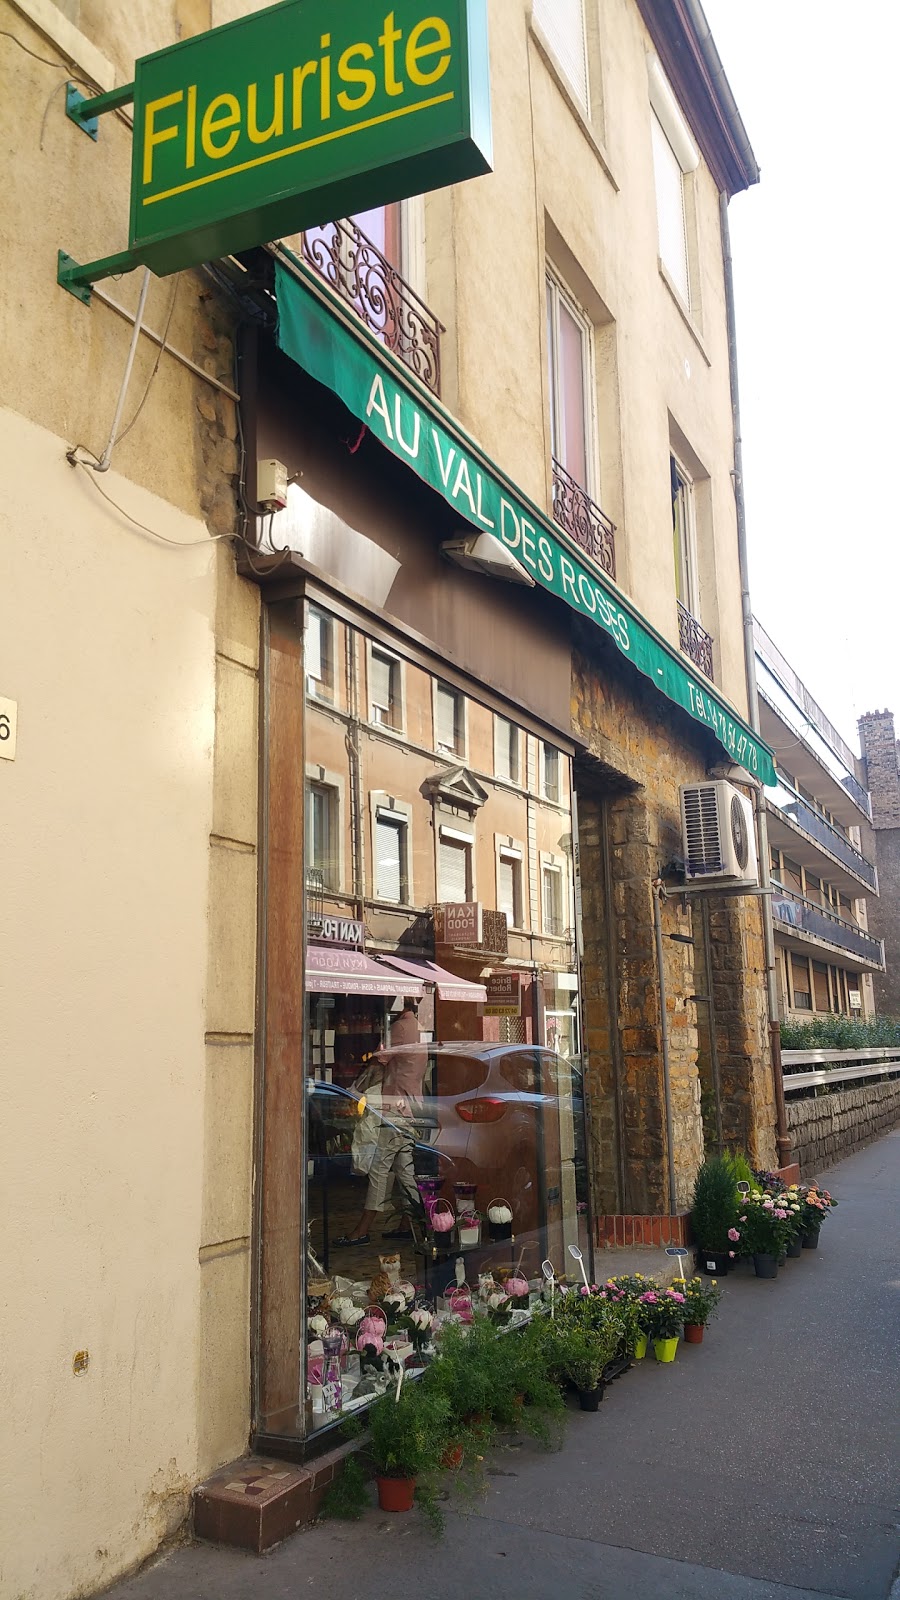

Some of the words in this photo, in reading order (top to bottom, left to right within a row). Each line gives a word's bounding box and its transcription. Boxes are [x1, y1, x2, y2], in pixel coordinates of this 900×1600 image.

[142, 11, 452, 185] Fleuriste
[366, 374, 420, 458] AU
[432, 429, 494, 528] VAL
[501, 497, 554, 582] DES
[561, 555, 630, 650] ROSES
[718, 712, 726, 743] 78
[728, 722, 736, 753] 54
[737, 734, 747, 761] 47
[748, 743, 758, 771] 78
